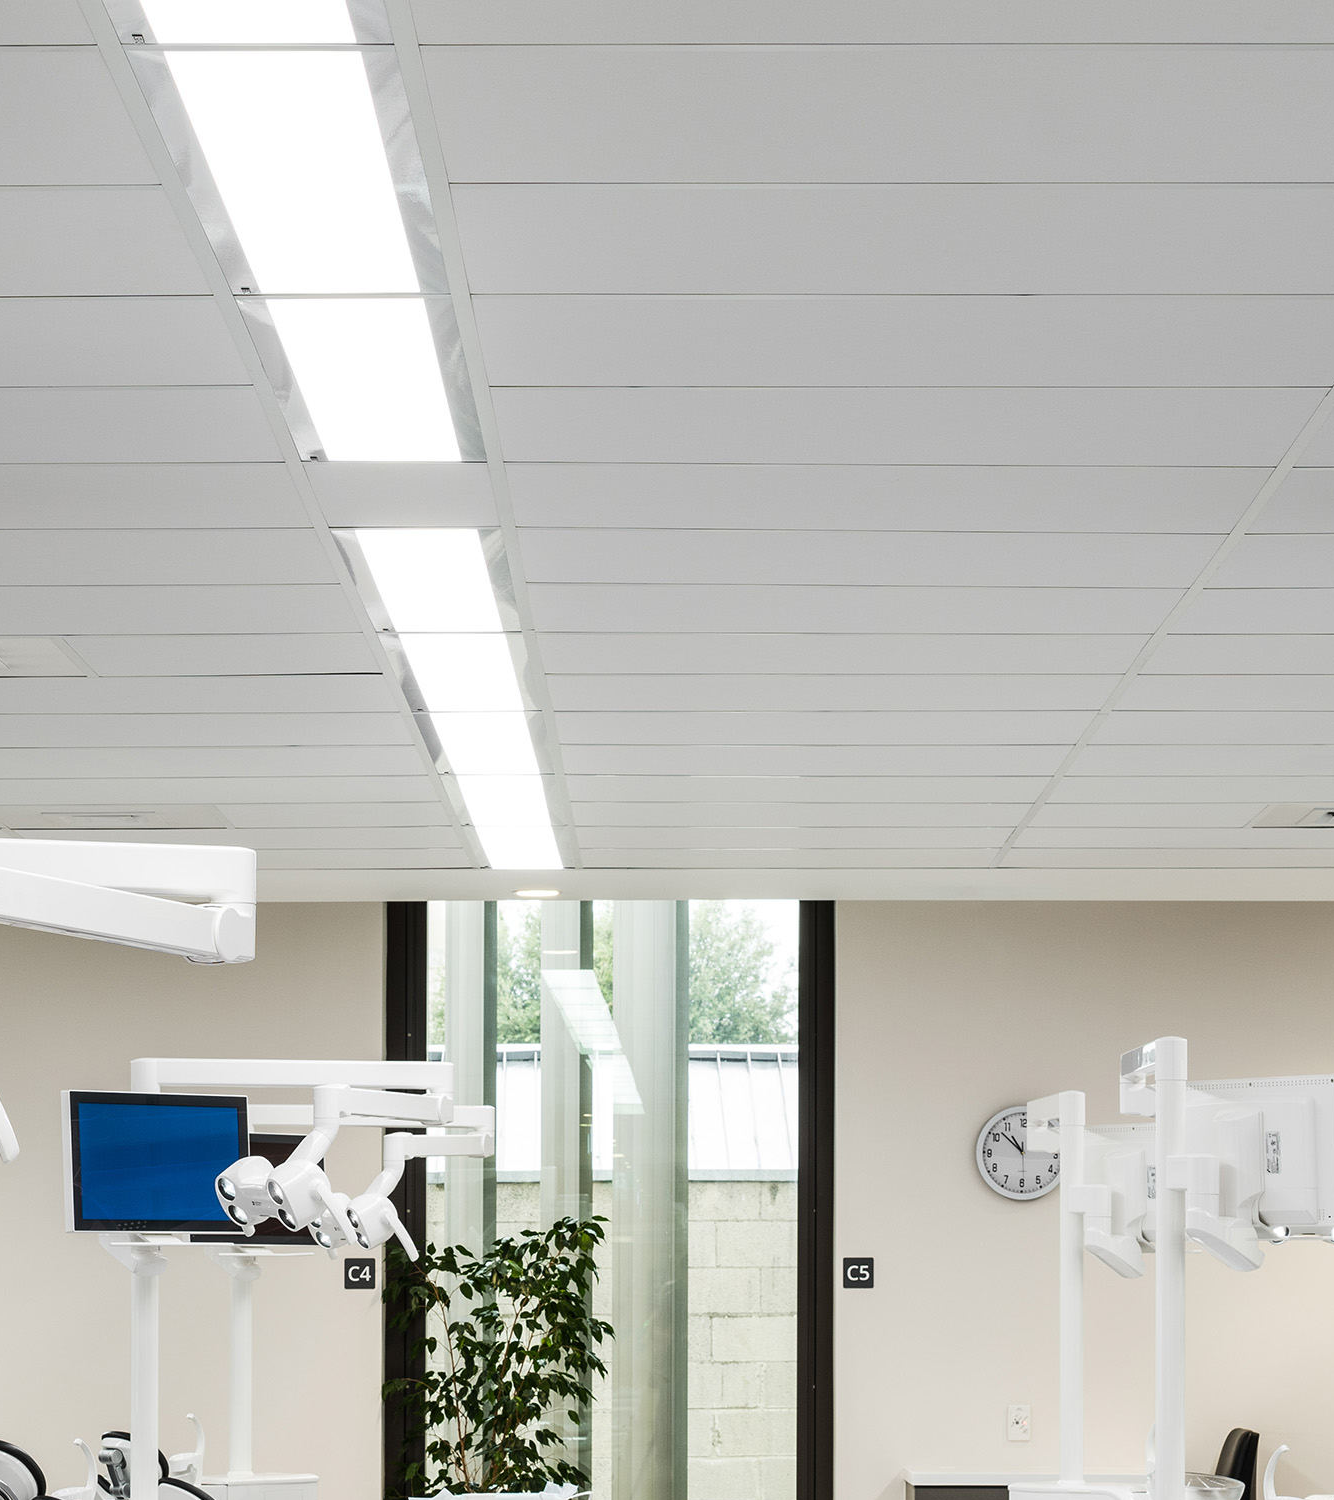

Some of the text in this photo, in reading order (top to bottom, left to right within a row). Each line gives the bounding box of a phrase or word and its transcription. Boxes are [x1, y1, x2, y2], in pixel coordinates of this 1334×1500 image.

[1004, 1118, 1028, 1132] 11 12
[992, 1132, 1001, 1143] 10
[987, 1148, 993, 1158] 9
[992, 1163, 1053, 1173] 8 4
[1004, 1174, 1041, 1188] 7 6 5
[347, 1265, 372, 1282] C4
[847, 1265, 870, 1282] C5
